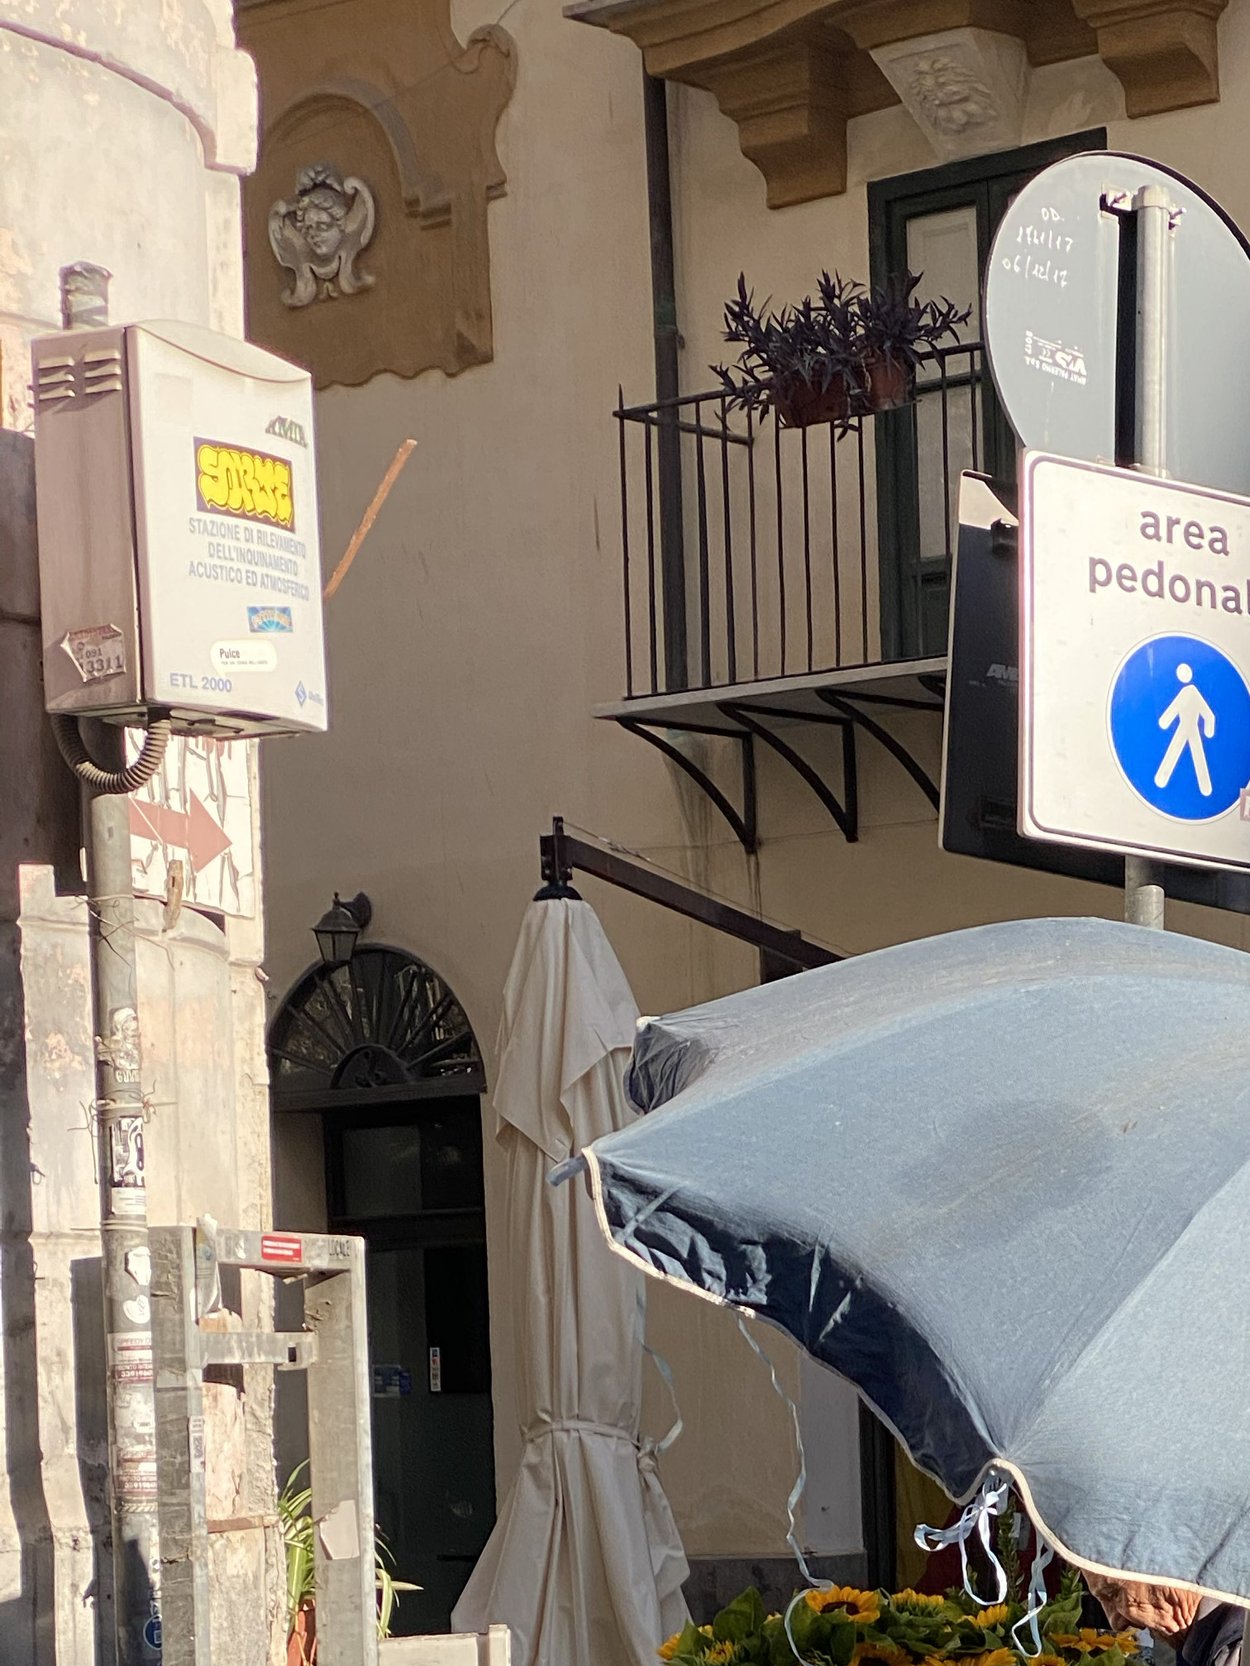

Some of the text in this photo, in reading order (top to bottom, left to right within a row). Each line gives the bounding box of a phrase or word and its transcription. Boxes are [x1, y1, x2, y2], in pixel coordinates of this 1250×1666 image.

[188, 517, 306, 559] STAZIONE DI RILEVAMENTO
[1140, 508, 1230, 556] area
[208, 541, 298, 576] DELL'INQUINAMENTO
[188, 561, 309, 601] ACUSTICO ED ATMOSFERICO
[170, 672, 233, 693] ETL 2000
